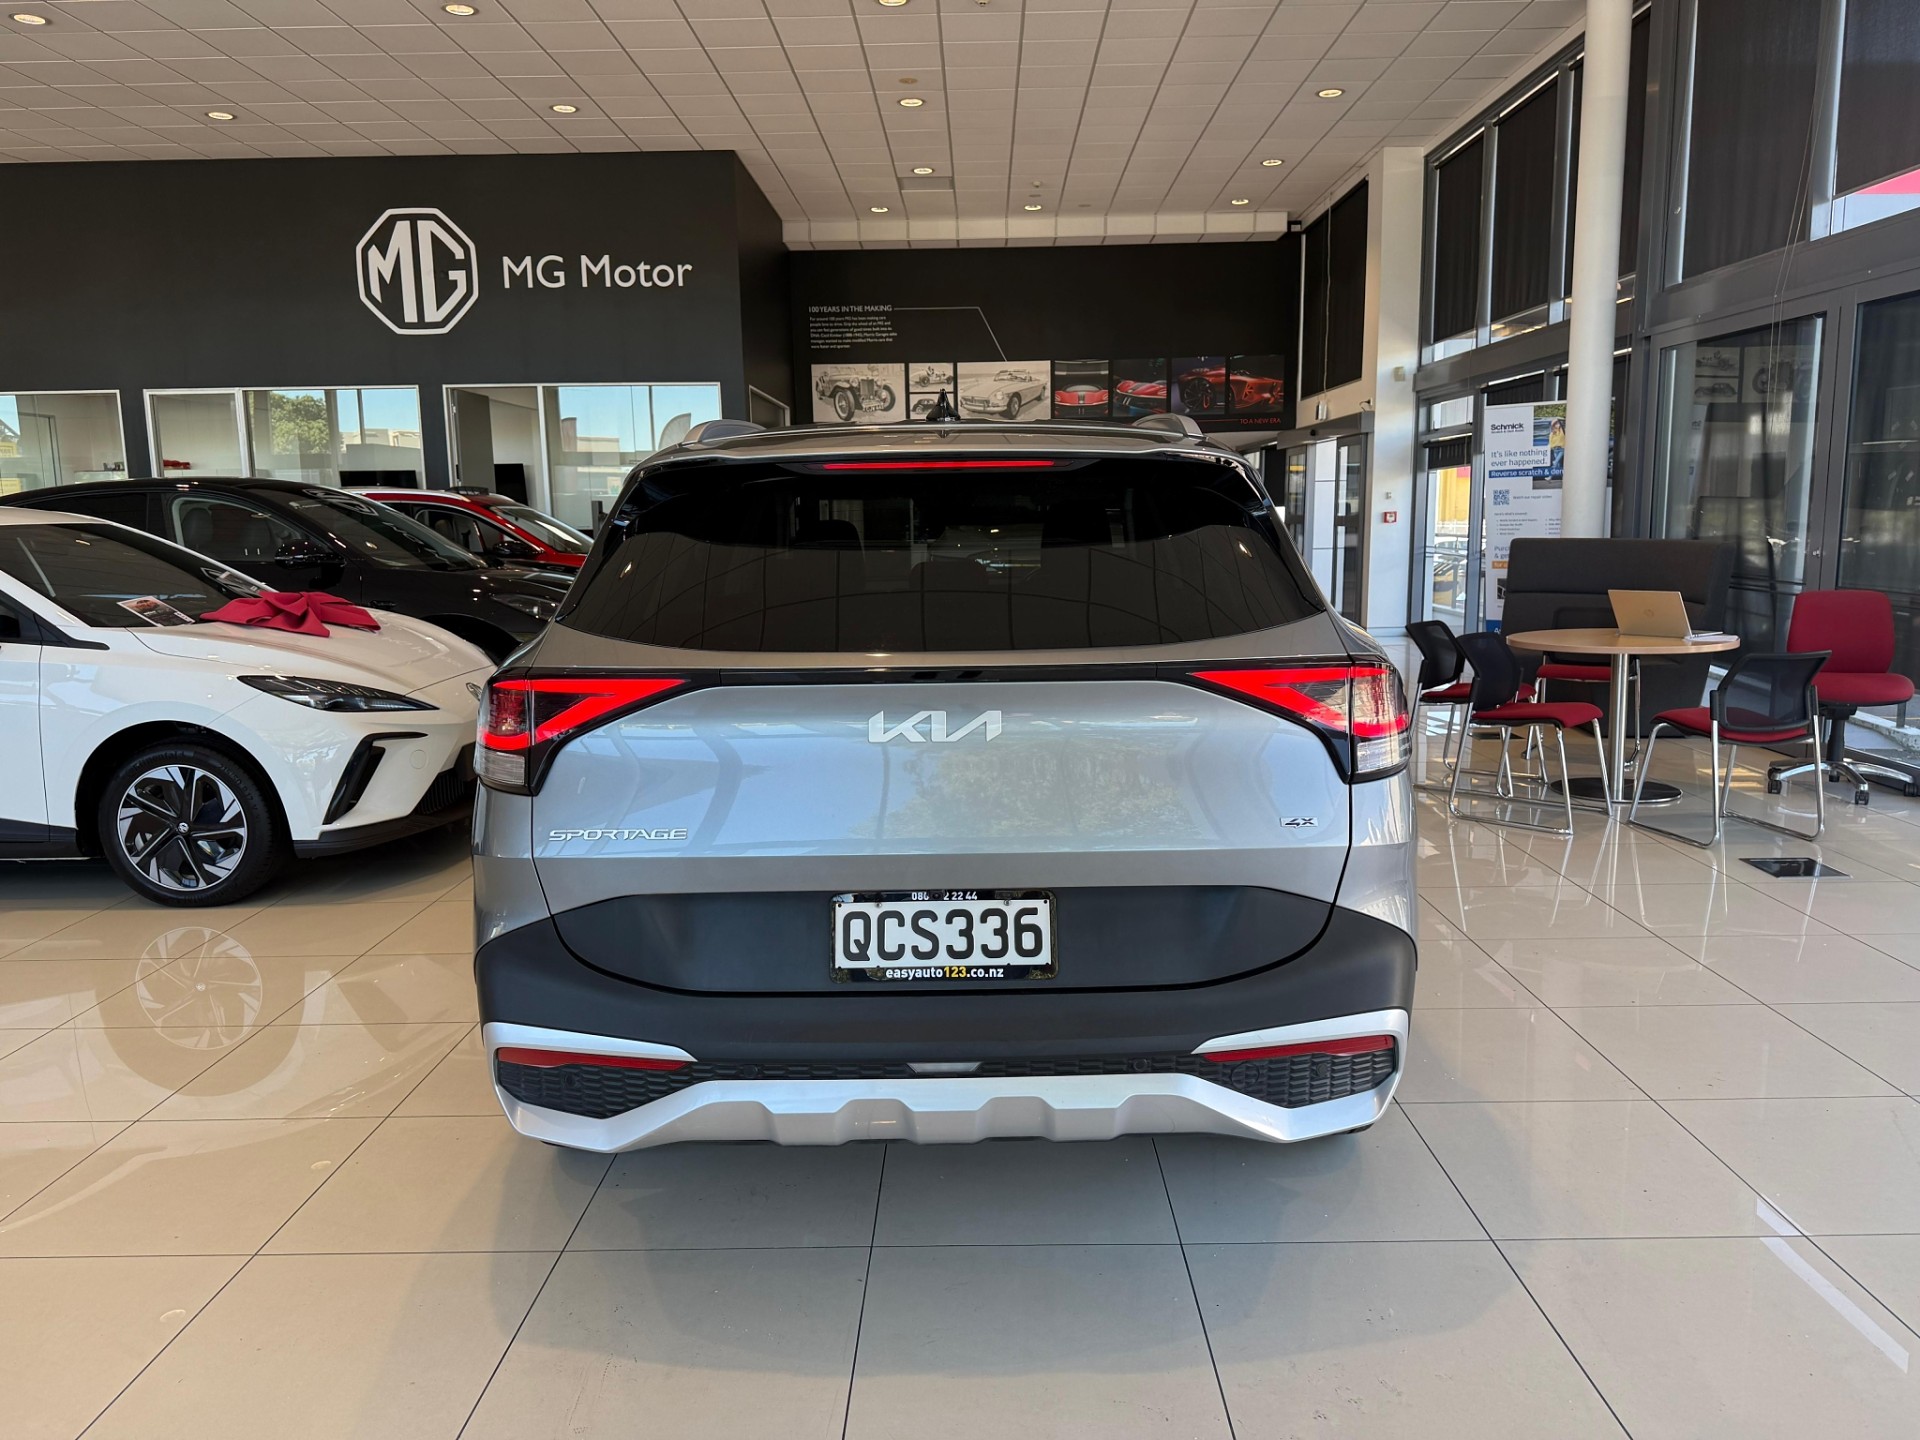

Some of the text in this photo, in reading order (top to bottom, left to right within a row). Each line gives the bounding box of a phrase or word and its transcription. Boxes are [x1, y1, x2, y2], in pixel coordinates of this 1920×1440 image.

[367, 220, 467, 323] MG
[502, 254, 693, 289] MG Motor
[1520, 449, 1548, 457] nothing
[1509, 458, 1548, 466] happened.
[868, 710, 1002, 743] KIA
[549, 828, 688, 841] SPORTAGE
[951, 891, 963, 900] 22
[966, 891, 977, 900] 44
[842, 907, 1043, 962] QCS336
[886, 966, 1004, 981] easyauto123.co.nz
